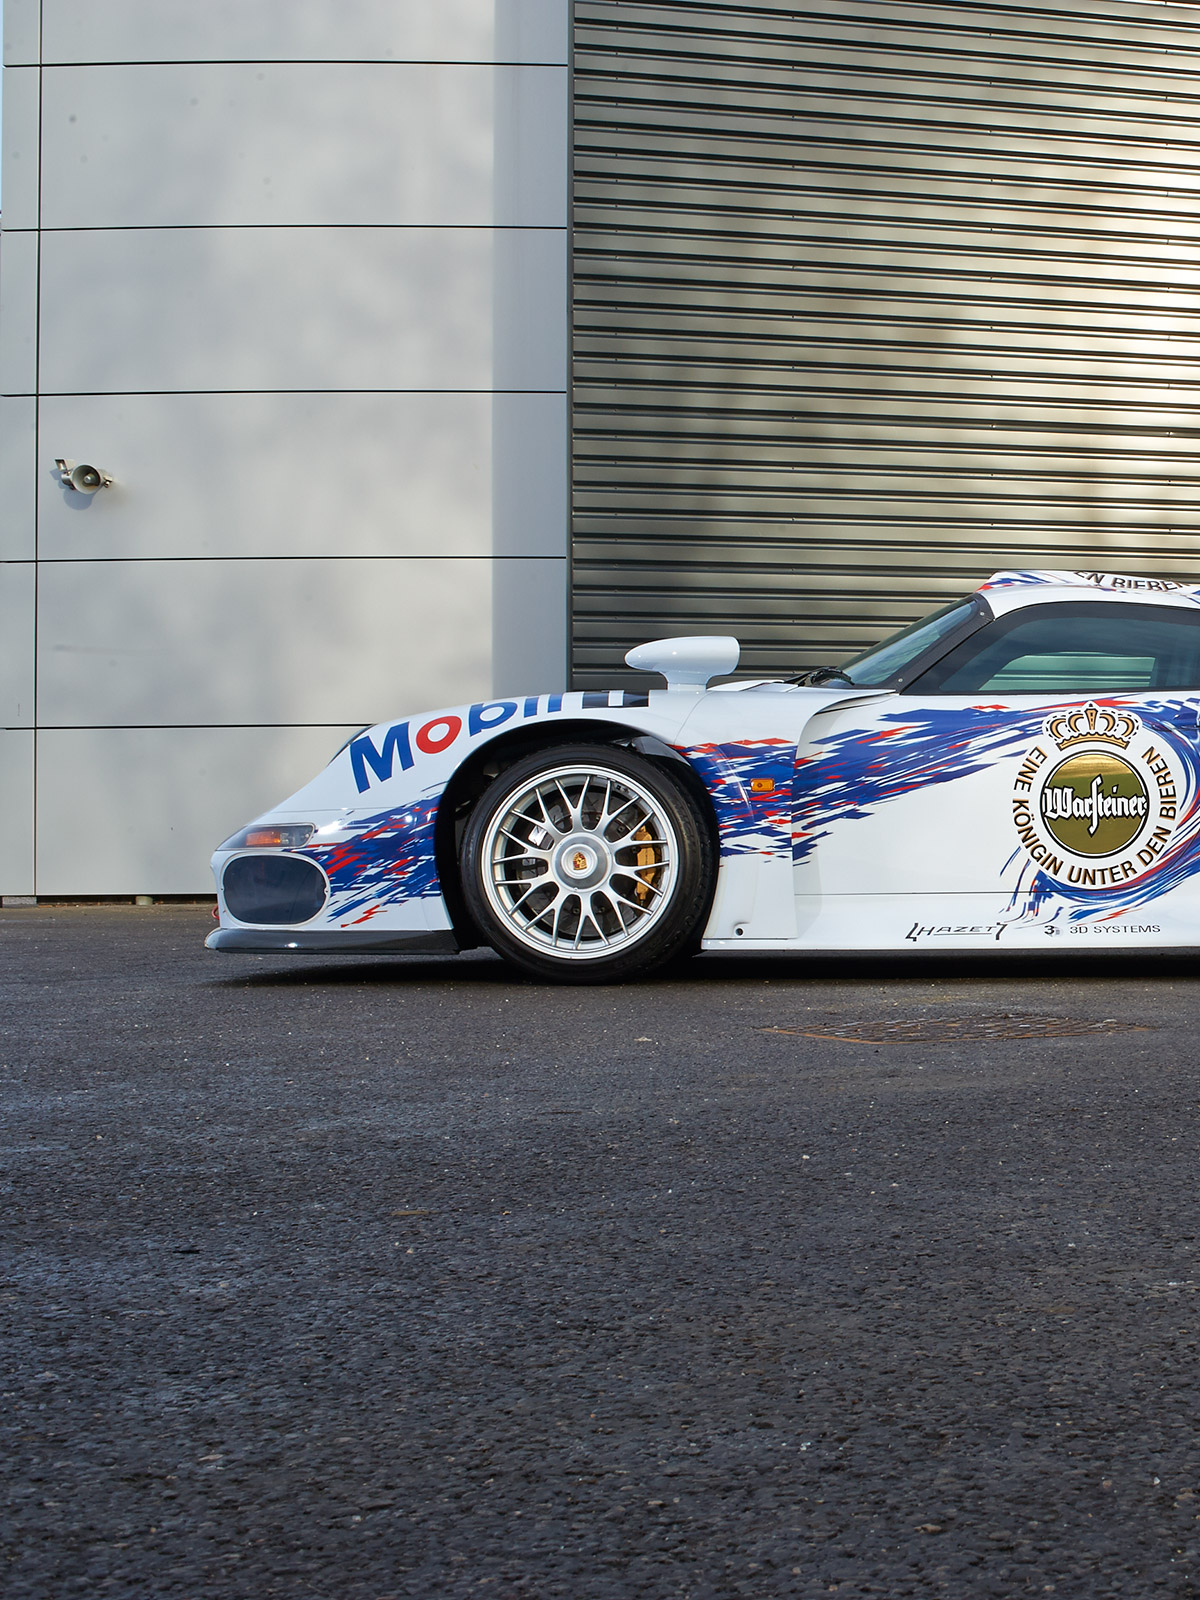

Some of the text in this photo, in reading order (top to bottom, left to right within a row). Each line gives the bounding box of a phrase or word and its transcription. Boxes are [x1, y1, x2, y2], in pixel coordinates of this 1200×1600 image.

[349, 693, 564, 794] Mobil
[1012, 746, 1178, 886] EINE KÖNIGIN UNTER DEN BIEREN
[1069, 924, 1162, 935] 3D SYSTEMS
